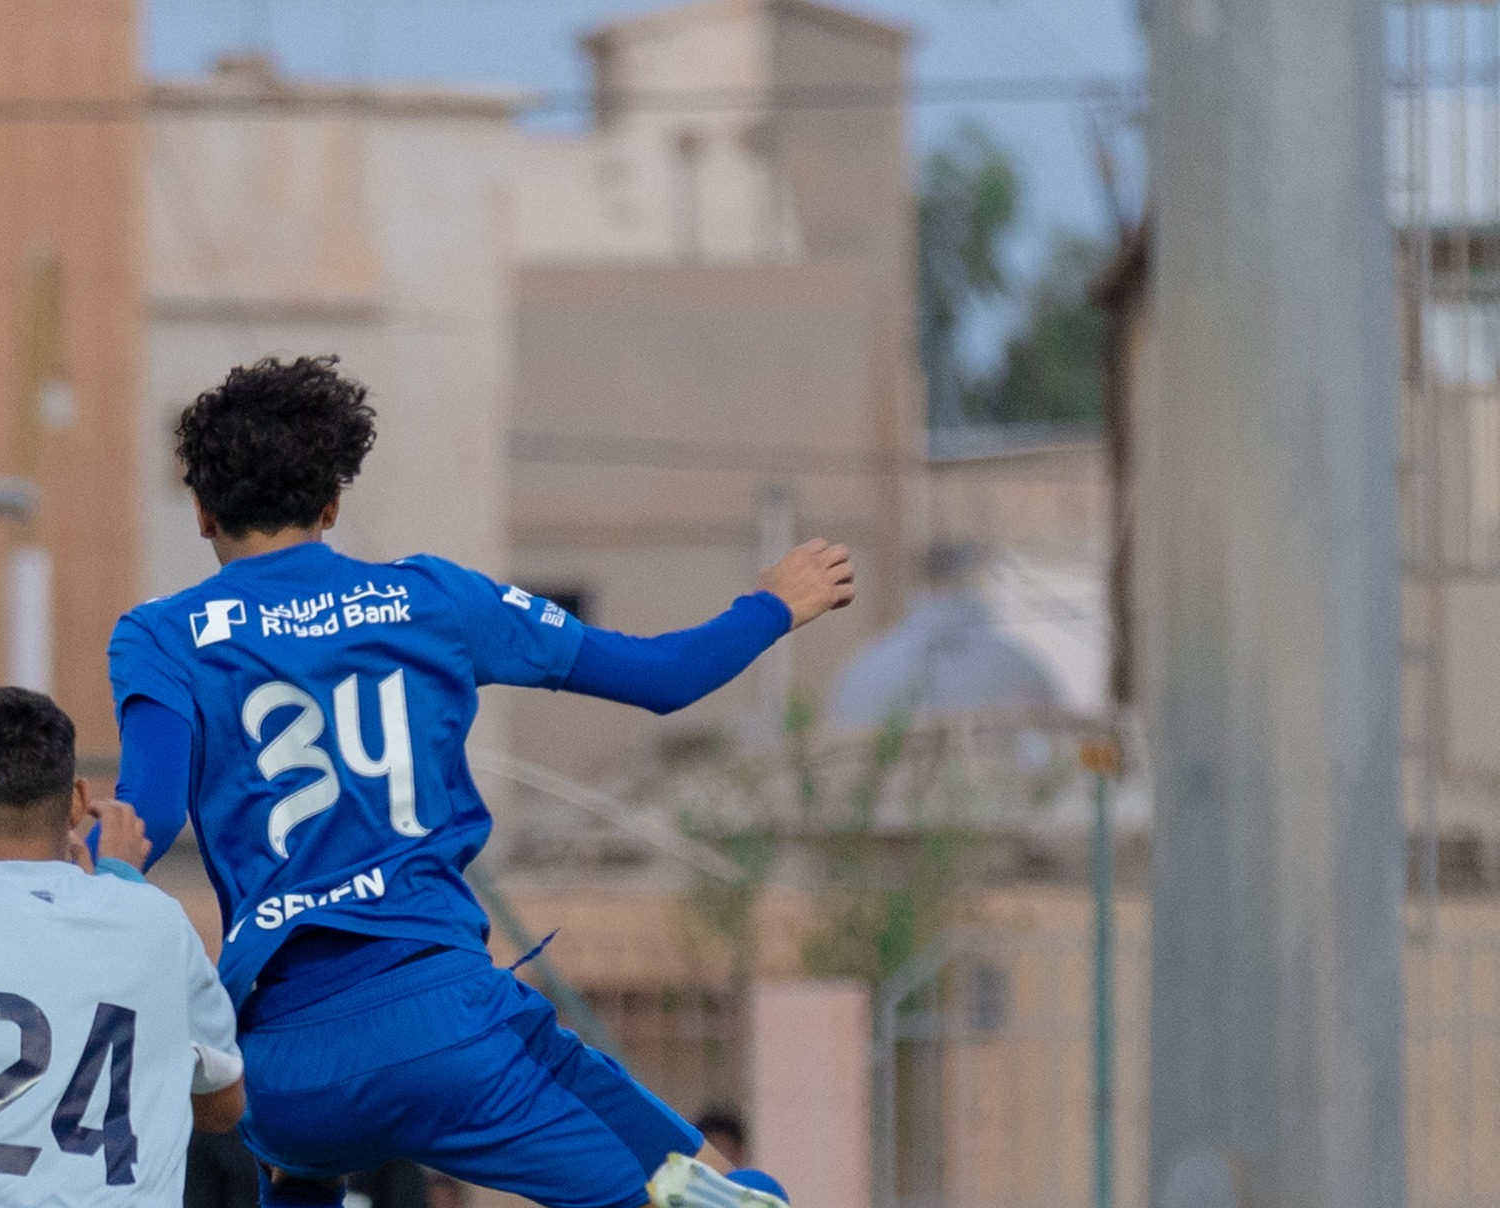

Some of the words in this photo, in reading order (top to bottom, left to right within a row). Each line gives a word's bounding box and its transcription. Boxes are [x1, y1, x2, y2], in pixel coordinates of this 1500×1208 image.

[258, 592, 335, 624] الرياض
[339, 581, 409, 604] بنك
[261, 612, 341, 638] Riyad
[342, 600, 412, 629] Bank
[241, 667, 433, 859] 34
